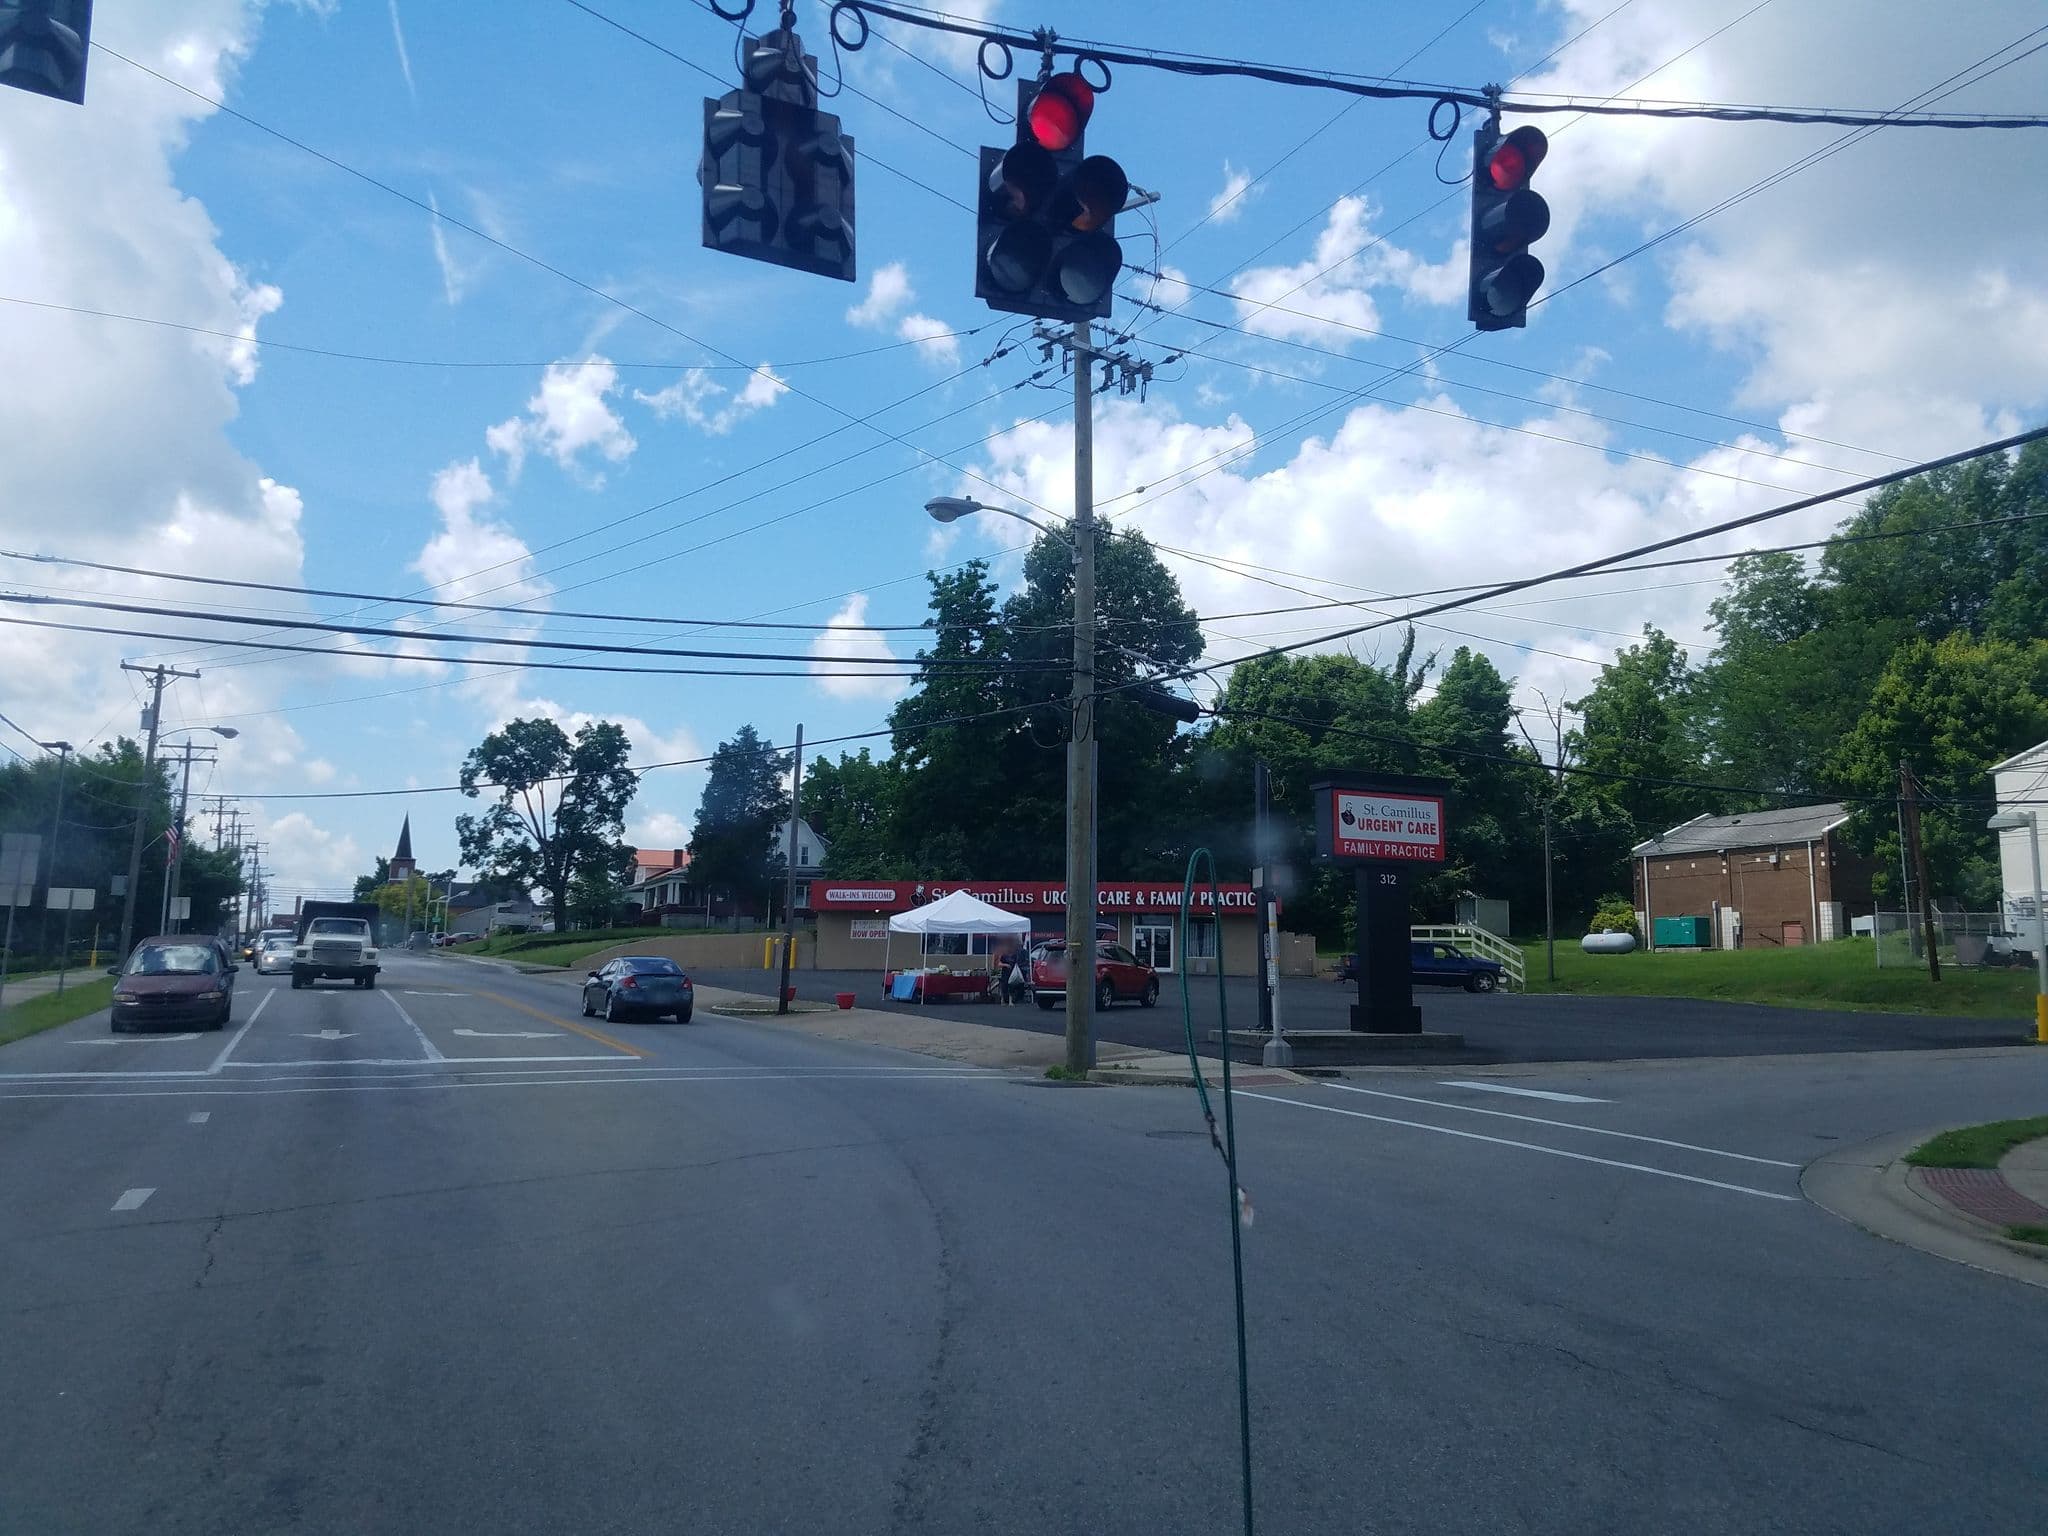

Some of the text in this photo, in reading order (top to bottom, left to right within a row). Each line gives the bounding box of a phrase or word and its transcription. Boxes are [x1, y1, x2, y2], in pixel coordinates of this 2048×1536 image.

[1381, 805, 1431, 820] Camillus
[1358, 817, 1437, 835] URGENT CARE
[1343, 841, 1436, 859] FAMILY PRACTICE
[1379, 874, 1397, 885] 312
[829, 891, 893, 899] WALK-INS WELCOME
[1098, 890, 1131, 905] CARE
[1136, 890, 1145, 905] &
[1150, 891, 1195, 906] FAMIY
[1200, 891, 1257, 906] PRACTIC
[852, 930, 886, 938] NOW OPEN
